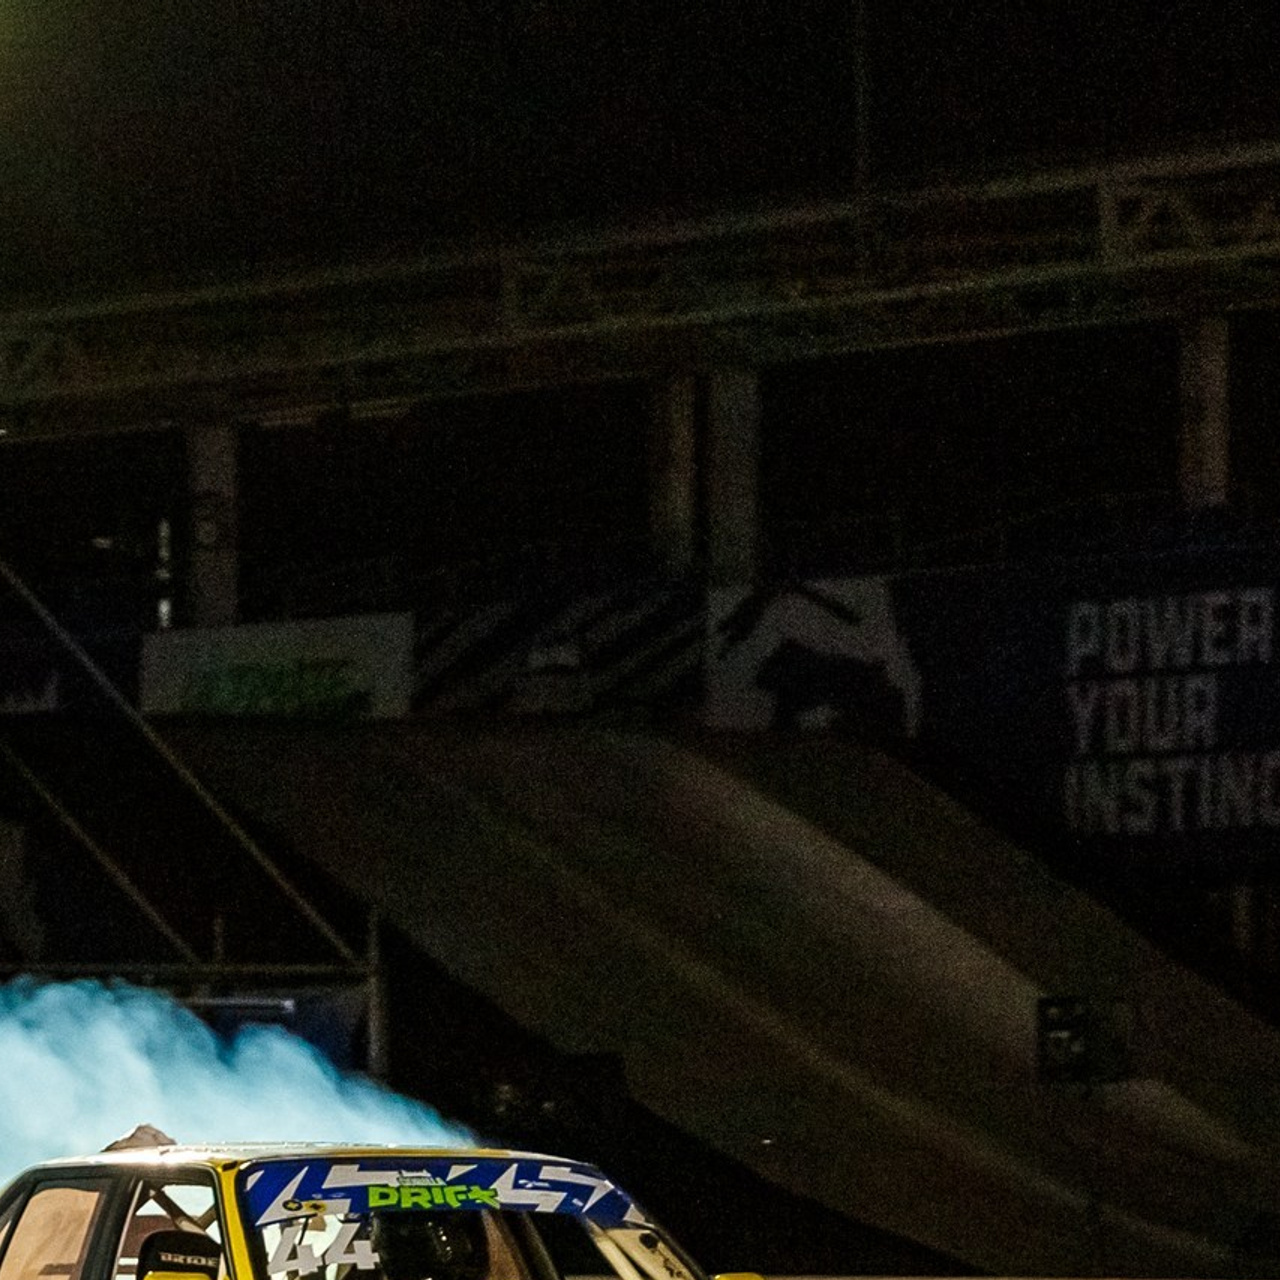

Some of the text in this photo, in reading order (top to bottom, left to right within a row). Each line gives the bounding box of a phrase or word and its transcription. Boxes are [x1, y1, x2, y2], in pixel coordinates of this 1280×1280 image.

[1066, 586, 1273, 676] POWER
[1062, 674, 1221, 754] YOUR
[267, 1222, 380, 1277] 44
